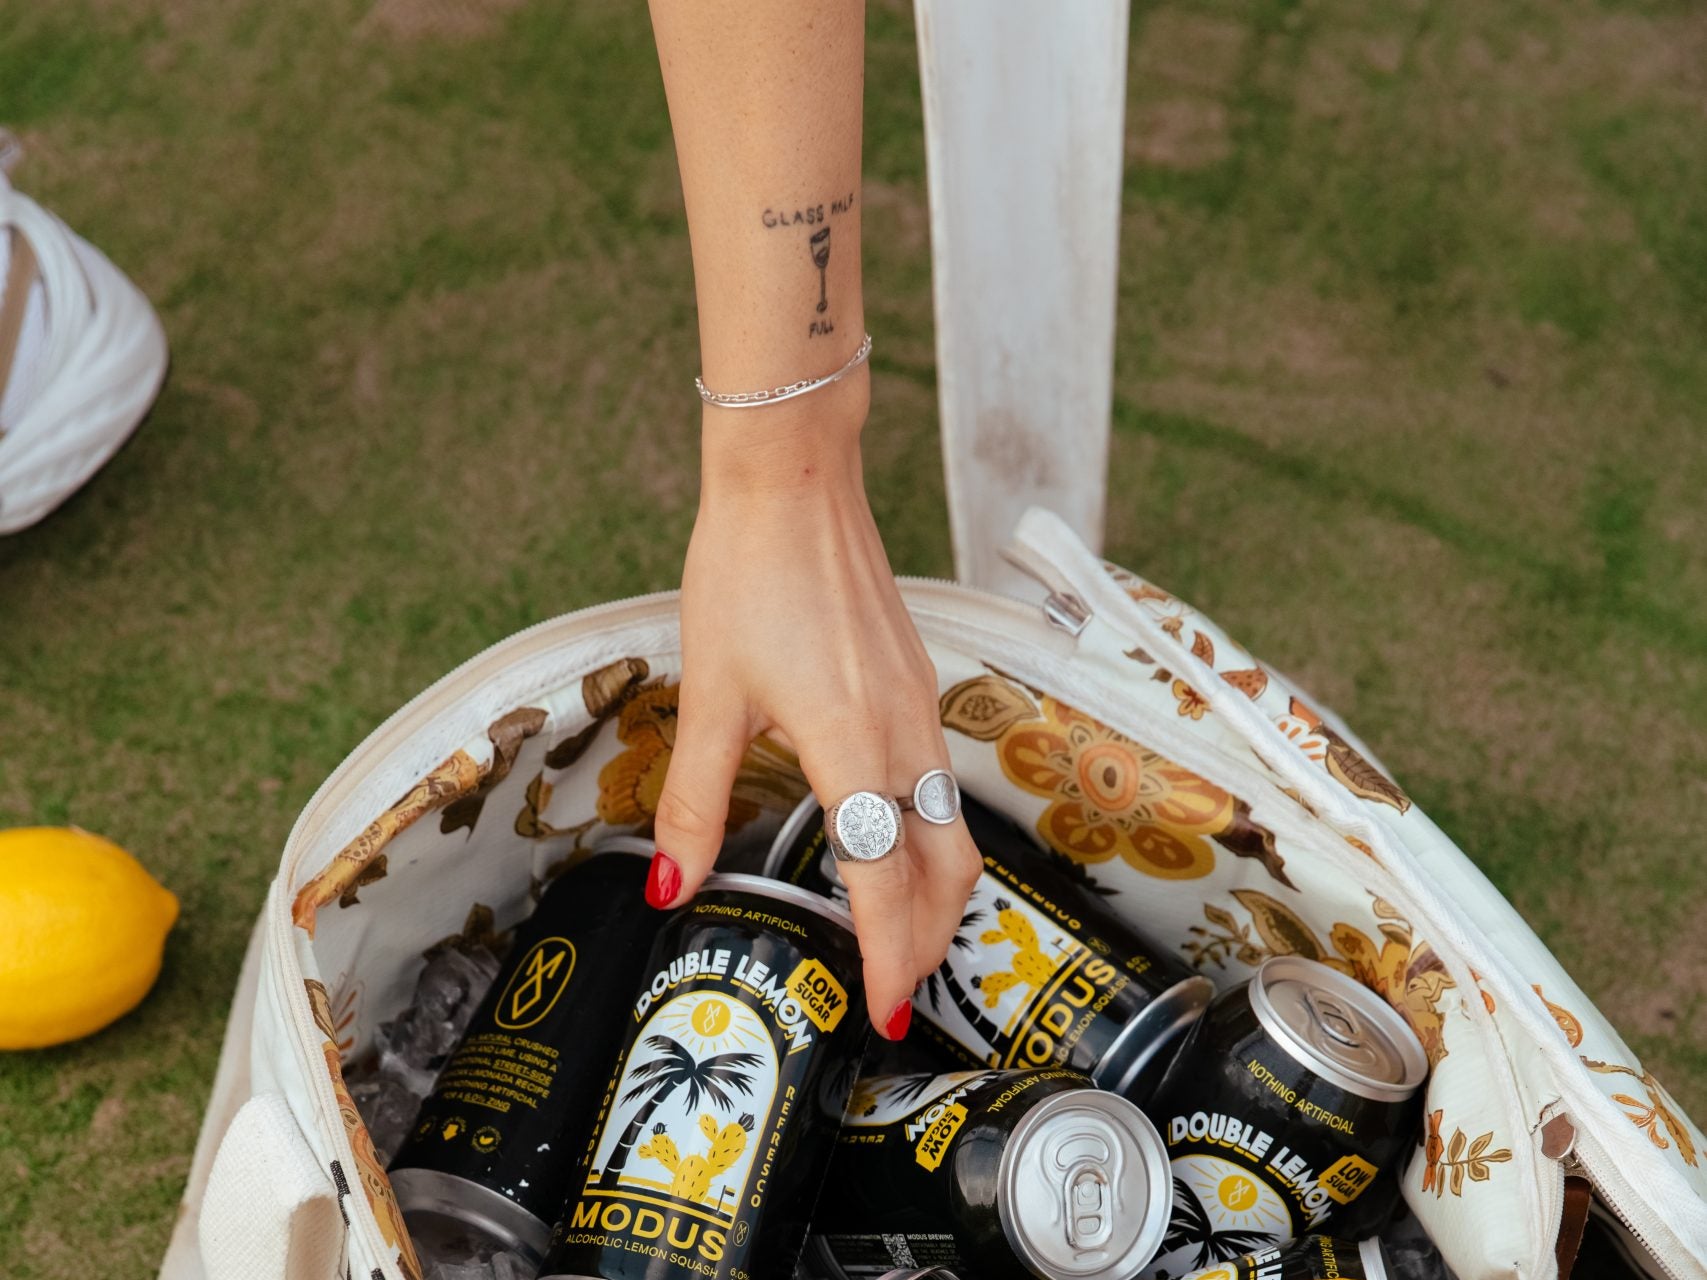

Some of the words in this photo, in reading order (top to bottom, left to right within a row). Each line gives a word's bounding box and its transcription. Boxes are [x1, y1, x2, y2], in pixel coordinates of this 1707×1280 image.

[762, 204, 824, 228] GLASS
[831, 193, 854, 214] HALF
[808, 319, 834, 339] FULL
[984, 856, 1082, 930] REFRESCO
[693, 904, 742, 917] NOTHING
[743, 910, 808, 937] ARTIFICIAL
[634, 949, 732, 1022] DOUBLE
[731, 954, 813, 1055] LEMON
[794, 982, 831, 1024] SUGAR
[803, 967, 842, 1011] LOW
[1017, 959, 1116, 1069] ODUS
[1065, 1010, 1096, 1051] LEMON
[1094, 975, 1131, 1014] SQUASH
[514, 1037, 559, 1058] CRUSHED
[518, 1053, 549, 1069] USING
[549, 1064, 557, 1072] A
[493, 1060, 553, 1087] STREET-SIDE
[515, 1078, 550, 1098] RECIPE
[987, 1075, 1040, 1113] ARTIFICIAL
[486, 1097, 511, 1112] ZING
[488, 1084, 538, 1109] ARTIFICIAL
[583, 1049, 624, 1167] LIMONADA
[1247, 1059, 1297, 1104] NOTHING
[1294, 1097, 1355, 1135] ARTIFICIAL
[751, 1085, 796, 1208] REFRESCO
[921, 1110, 952, 1153] SUGAR
[929, 1113, 960, 1162] LOW
[1168, 1111, 1275, 1162] DOUBLE
[1265, 1146, 1333, 1231] LEMON
[1326, 1175, 1356, 1198] SUGAR
[1338, 1162, 1371, 1187] LOW
[571, 1201, 727, 1262] MODUS
[565, 1234, 623, 1249] ALCOHOLIC
[624, 1240, 668, 1260] LEMON
[669, 1253, 719, 1279] SQUASH
[1320, 1248, 1340, 1279] ARTIFIC
